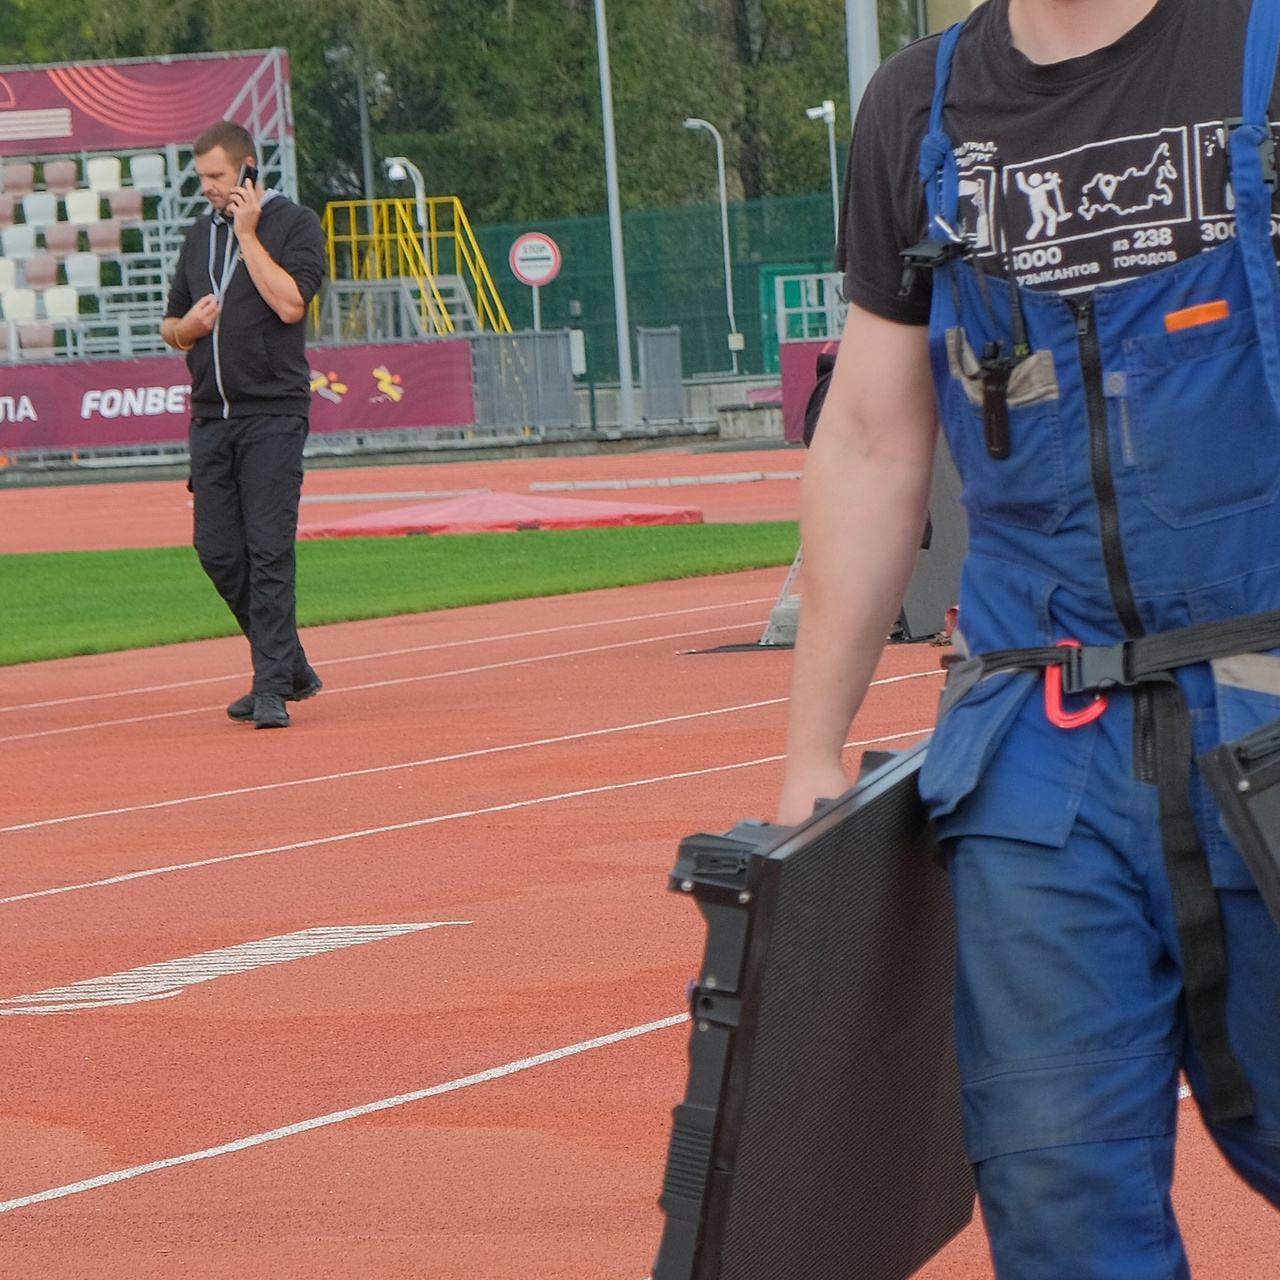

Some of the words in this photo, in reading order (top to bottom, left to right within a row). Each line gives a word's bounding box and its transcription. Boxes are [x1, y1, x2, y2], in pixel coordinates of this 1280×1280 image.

[1133, 227, 1173, 249] 238
[1016, 262, 1100, 287] УЗЫКАНТОВ
[1113, 251, 1178, 269] ГОРОДОВ
[80, 384, 192, 419] FONBE
